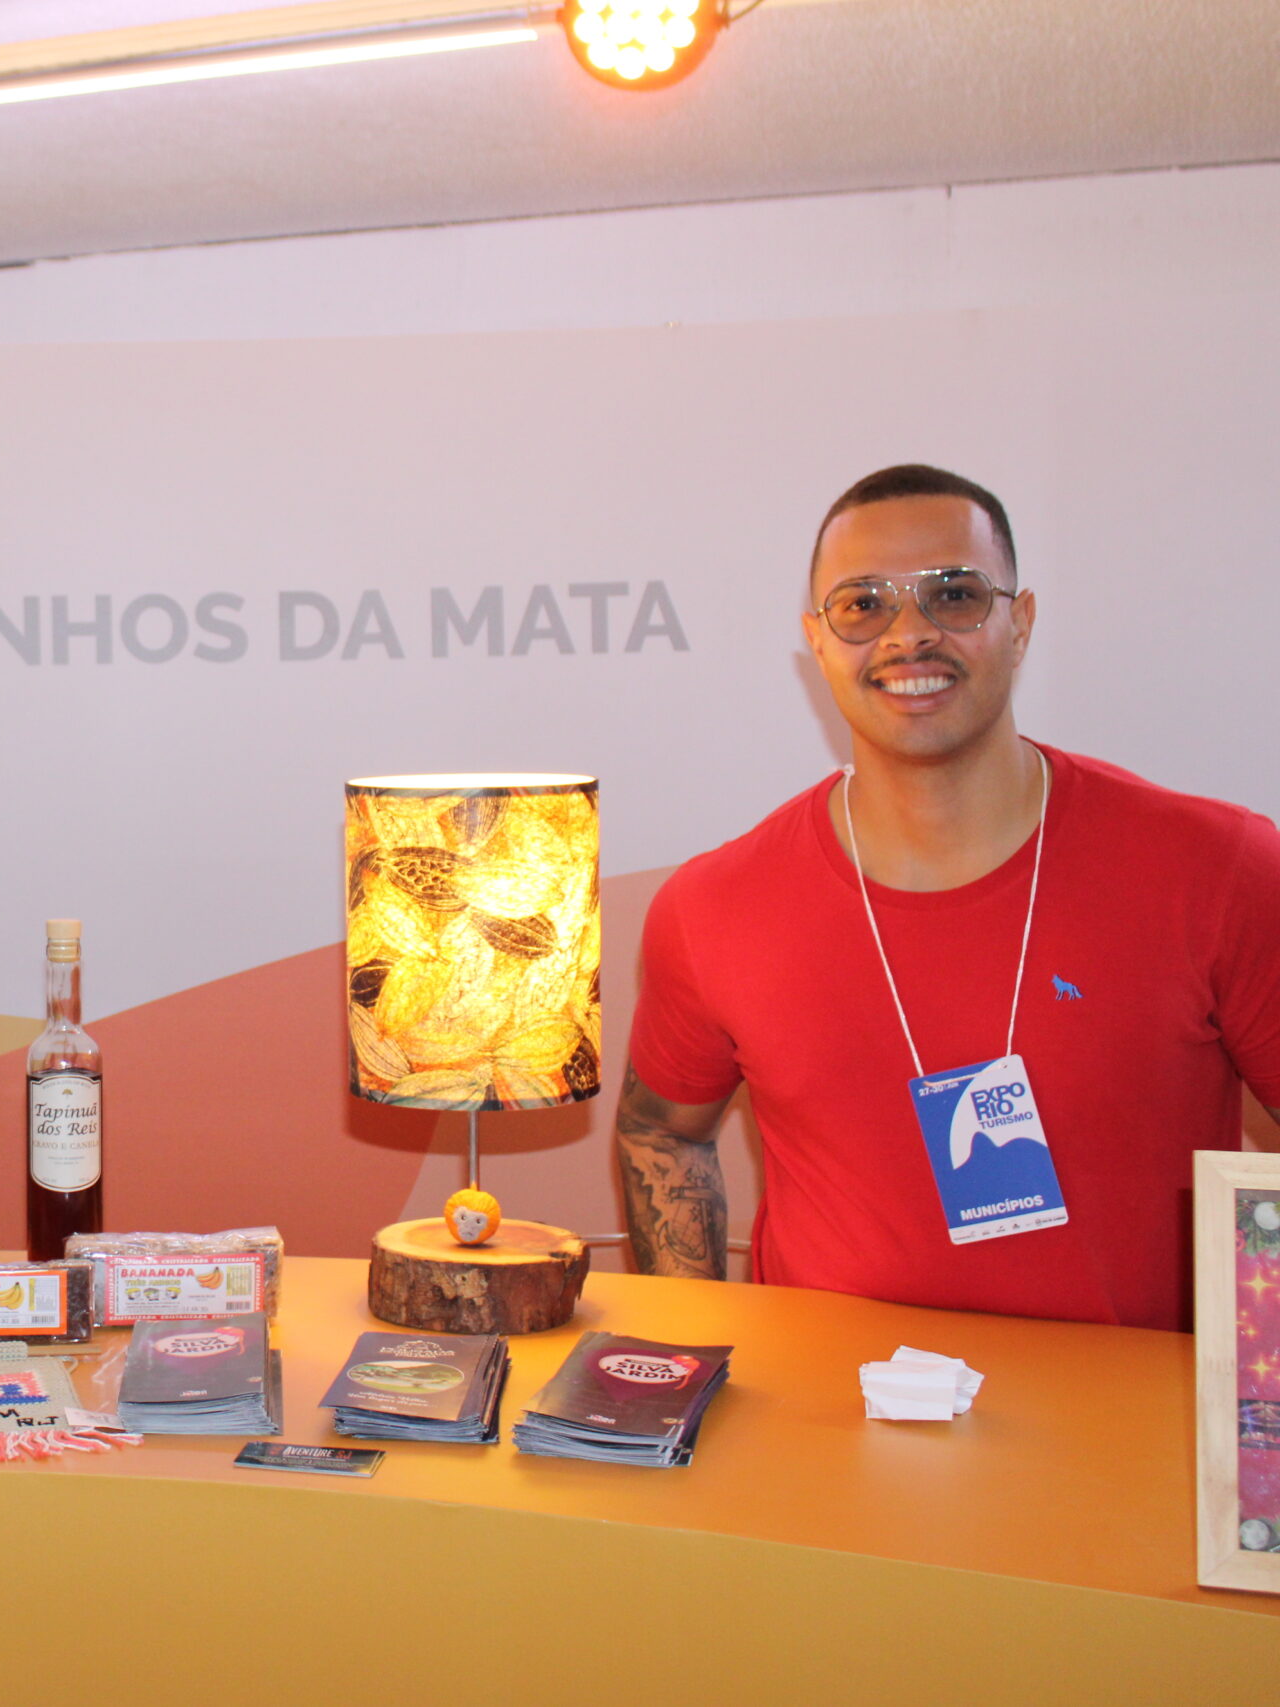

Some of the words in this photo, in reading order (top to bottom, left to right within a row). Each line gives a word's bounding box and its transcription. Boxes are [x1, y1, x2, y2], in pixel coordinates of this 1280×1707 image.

[278, 588, 406, 661] DA
[430, 579, 692, 659] MATA
[971, 1082, 1025, 1105] EXPO
[34, 1102, 97, 1123] Tapinuã
[976, 1099, 1015, 1121] RIO
[37, 1119, 62, 1136] dos
[67, 1121, 98, 1136] Reis
[979, 1111, 1033, 1129] TURISMO
[960, 1194, 1045, 1220] MUNICÍPIOS
[120, 1267, 196, 1278] BANANADA
[171, 1338, 226, 1348] SILVA
[605, 1365, 686, 1381] JARDIM
[616, 1360, 674, 1374] SILVA
[282, 1445, 335, 1458] AVENTURE
